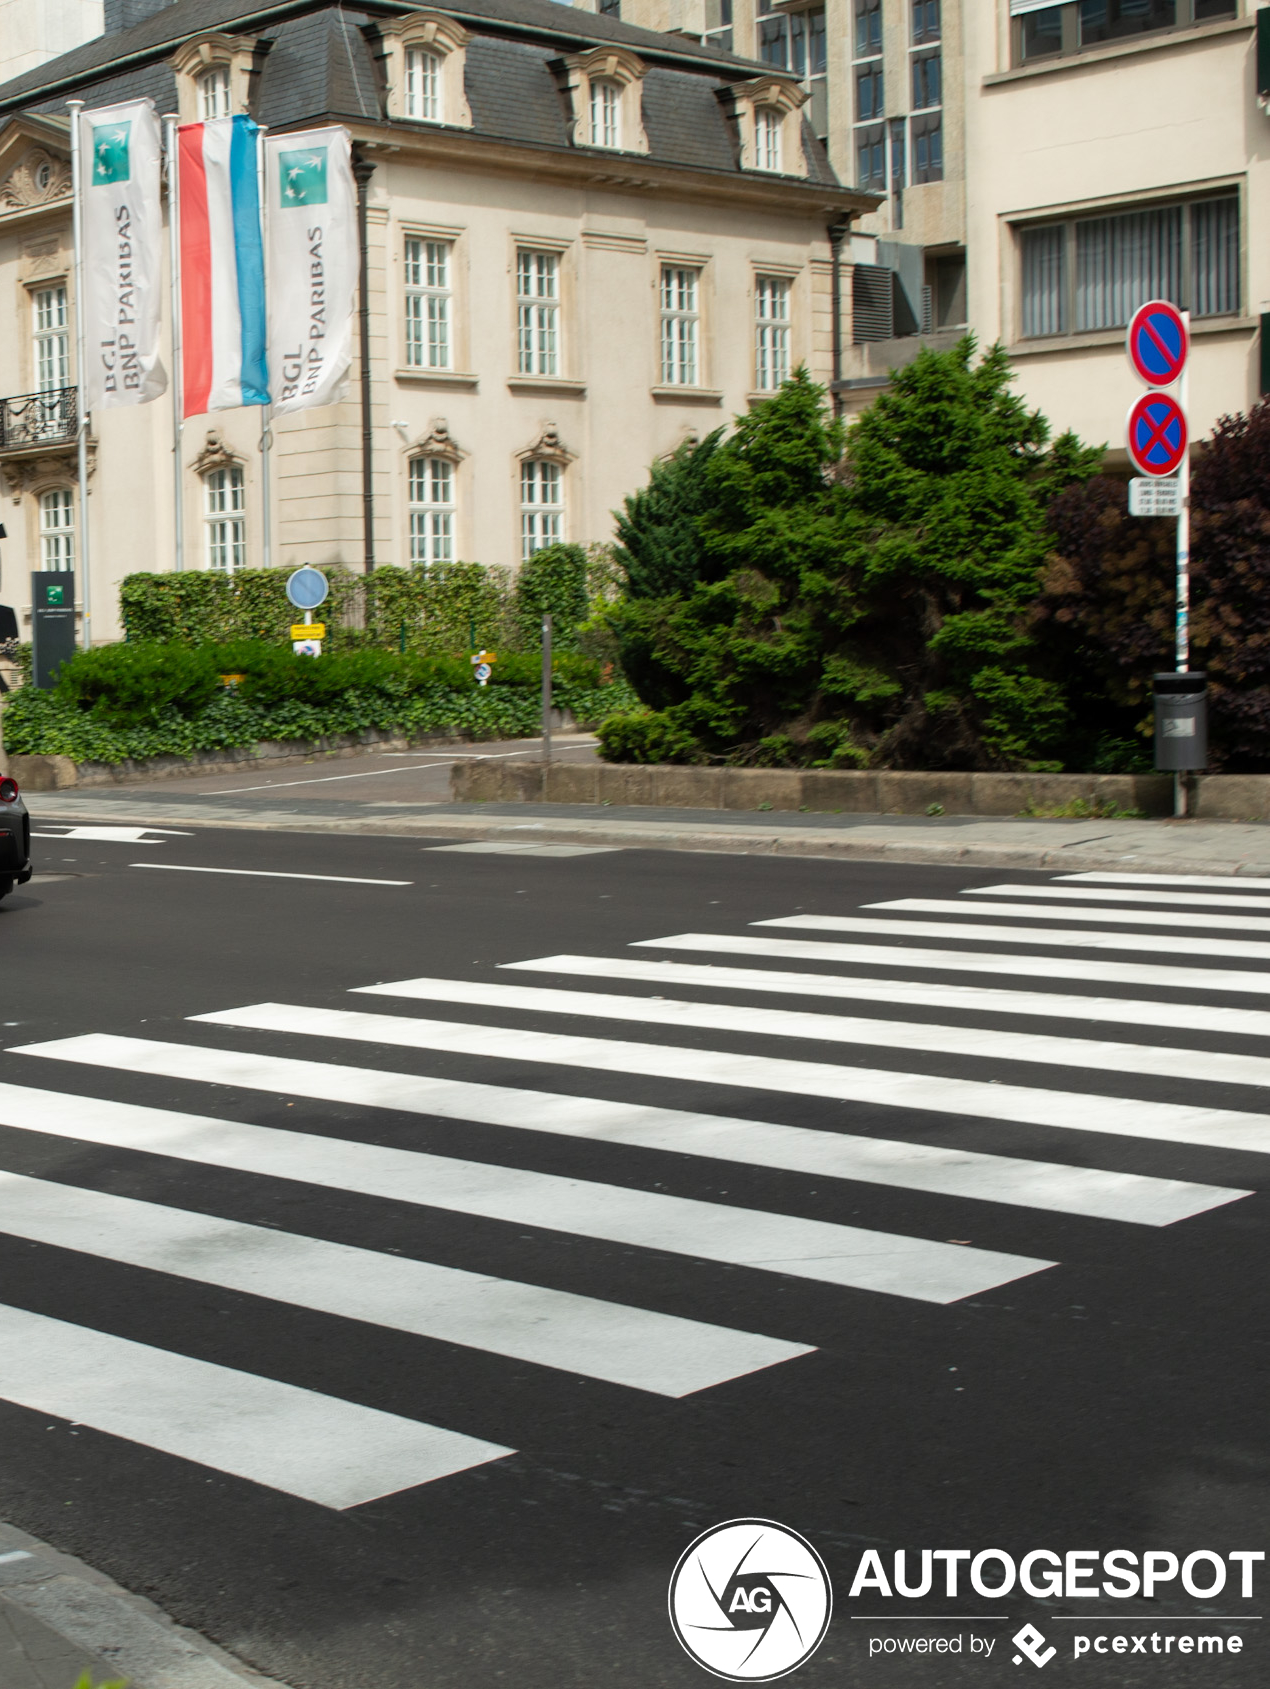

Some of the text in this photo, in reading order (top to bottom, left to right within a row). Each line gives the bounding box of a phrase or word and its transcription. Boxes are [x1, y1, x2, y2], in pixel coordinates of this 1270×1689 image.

[115, 204, 140, 390] BNP PARIBAS
[282, 344, 303, 402] BGL
[302, 226, 326, 396] BNP PARIBAS
